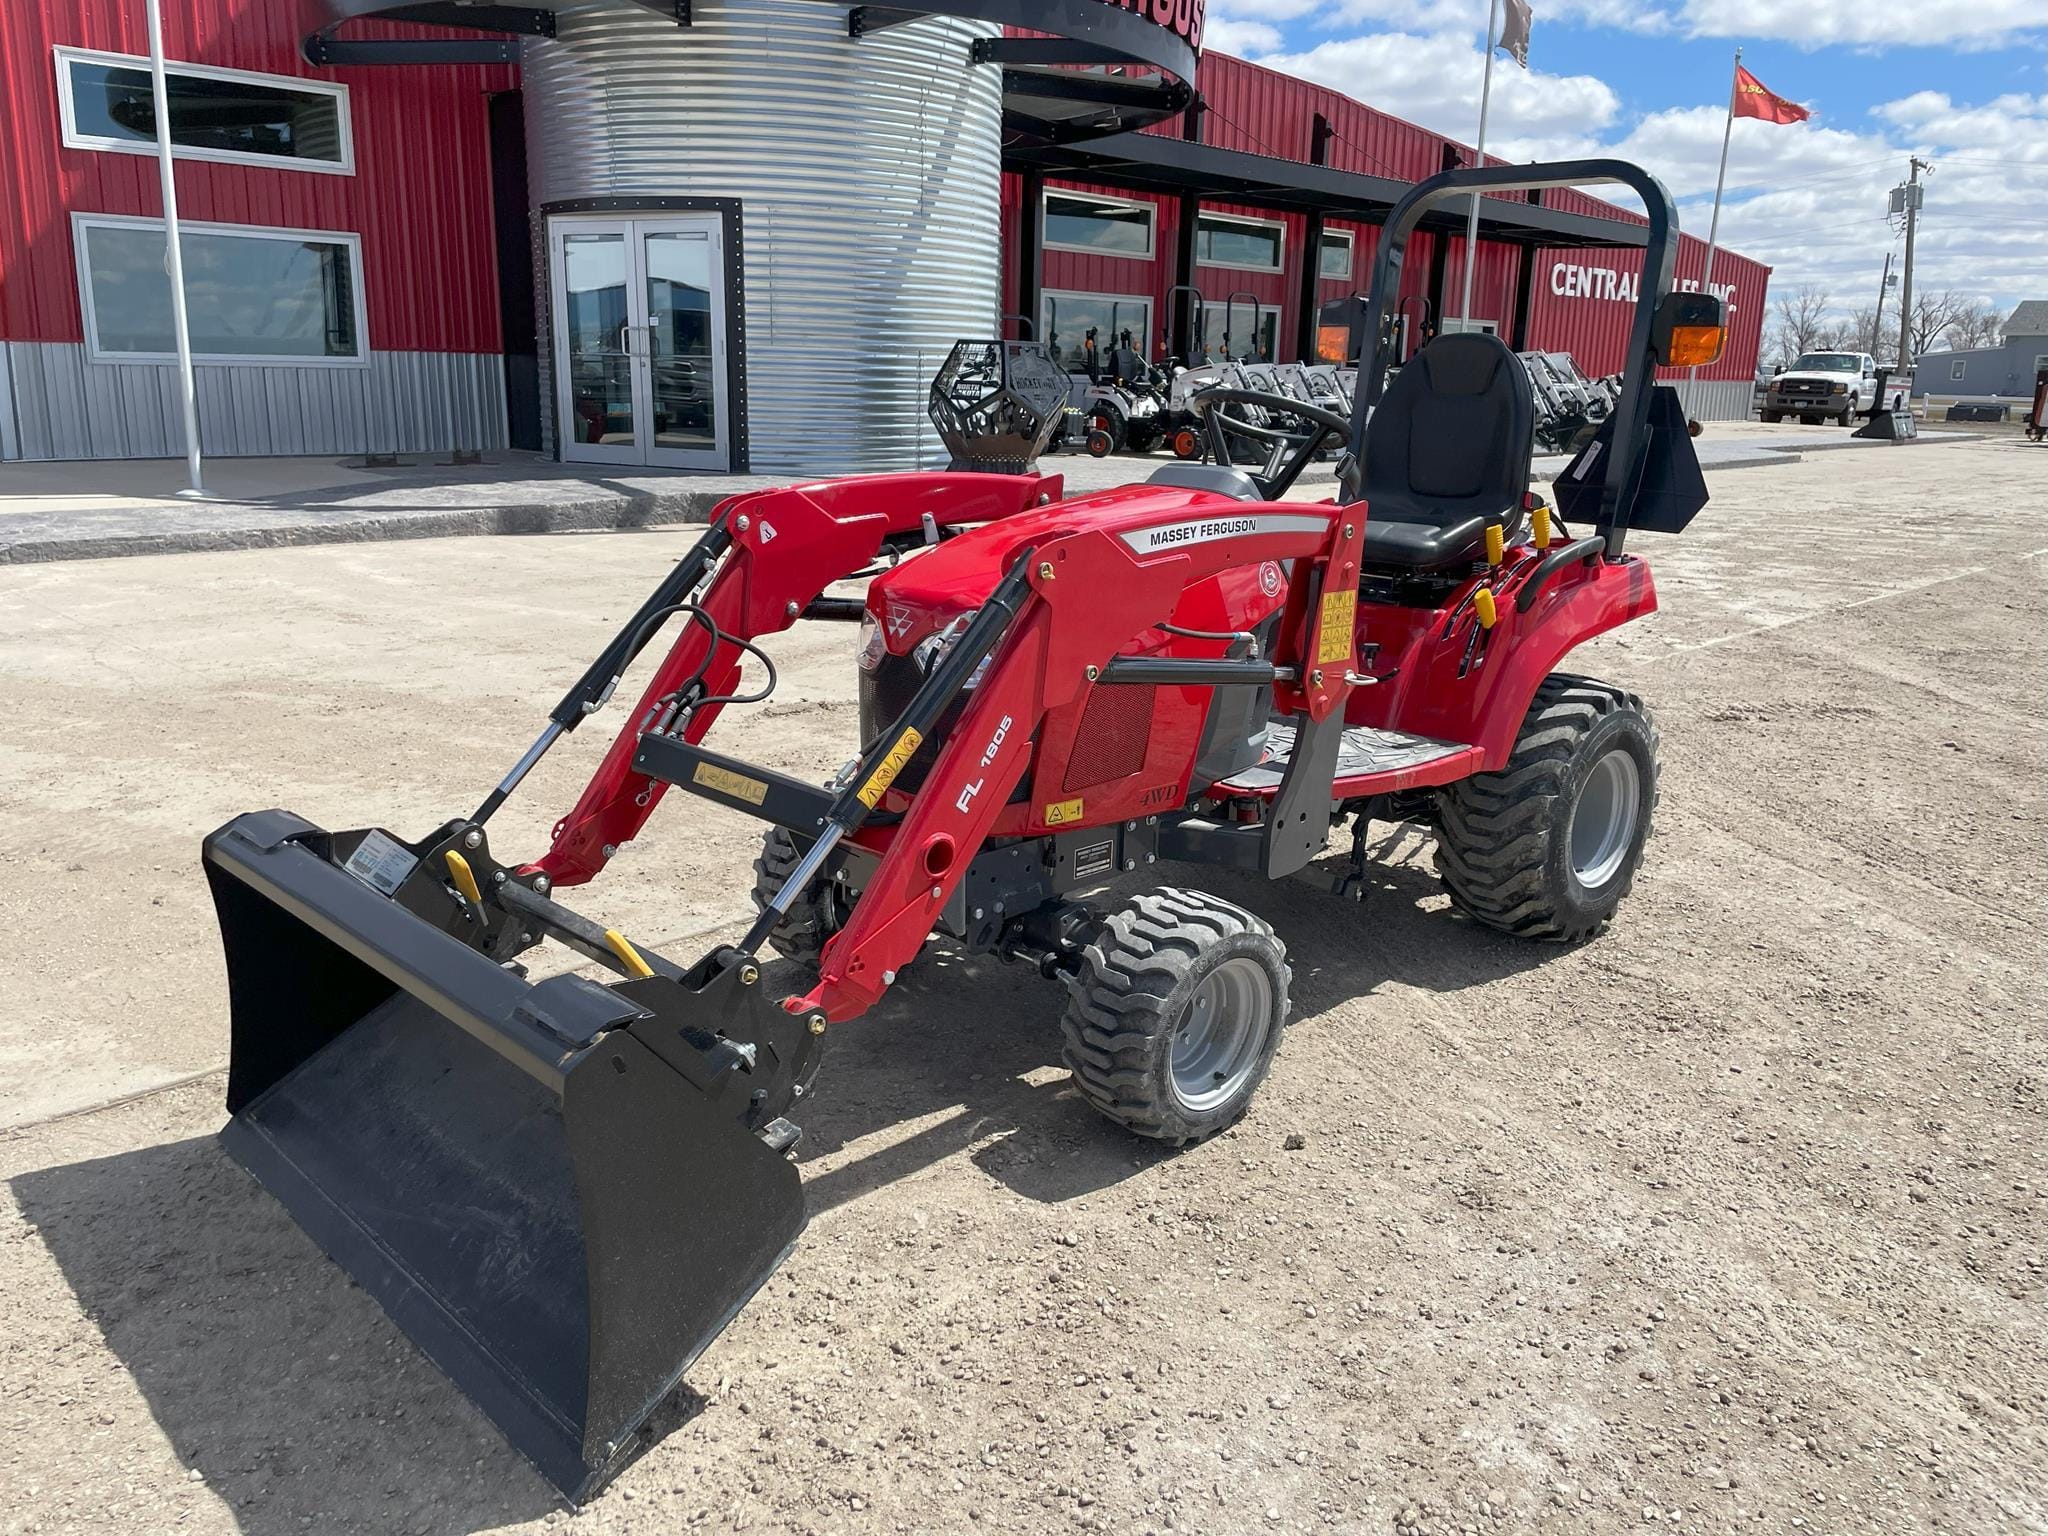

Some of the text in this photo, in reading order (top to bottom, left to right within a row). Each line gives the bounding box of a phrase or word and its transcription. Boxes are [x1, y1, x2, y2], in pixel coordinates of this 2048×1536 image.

[1551, 262, 1639, 303] CENTRAL
[1150, 519, 1257, 546] MASSEY FERGUSON
[956, 714, 1012, 814] FL 1805
[1140, 785, 1178, 806] 4WD
